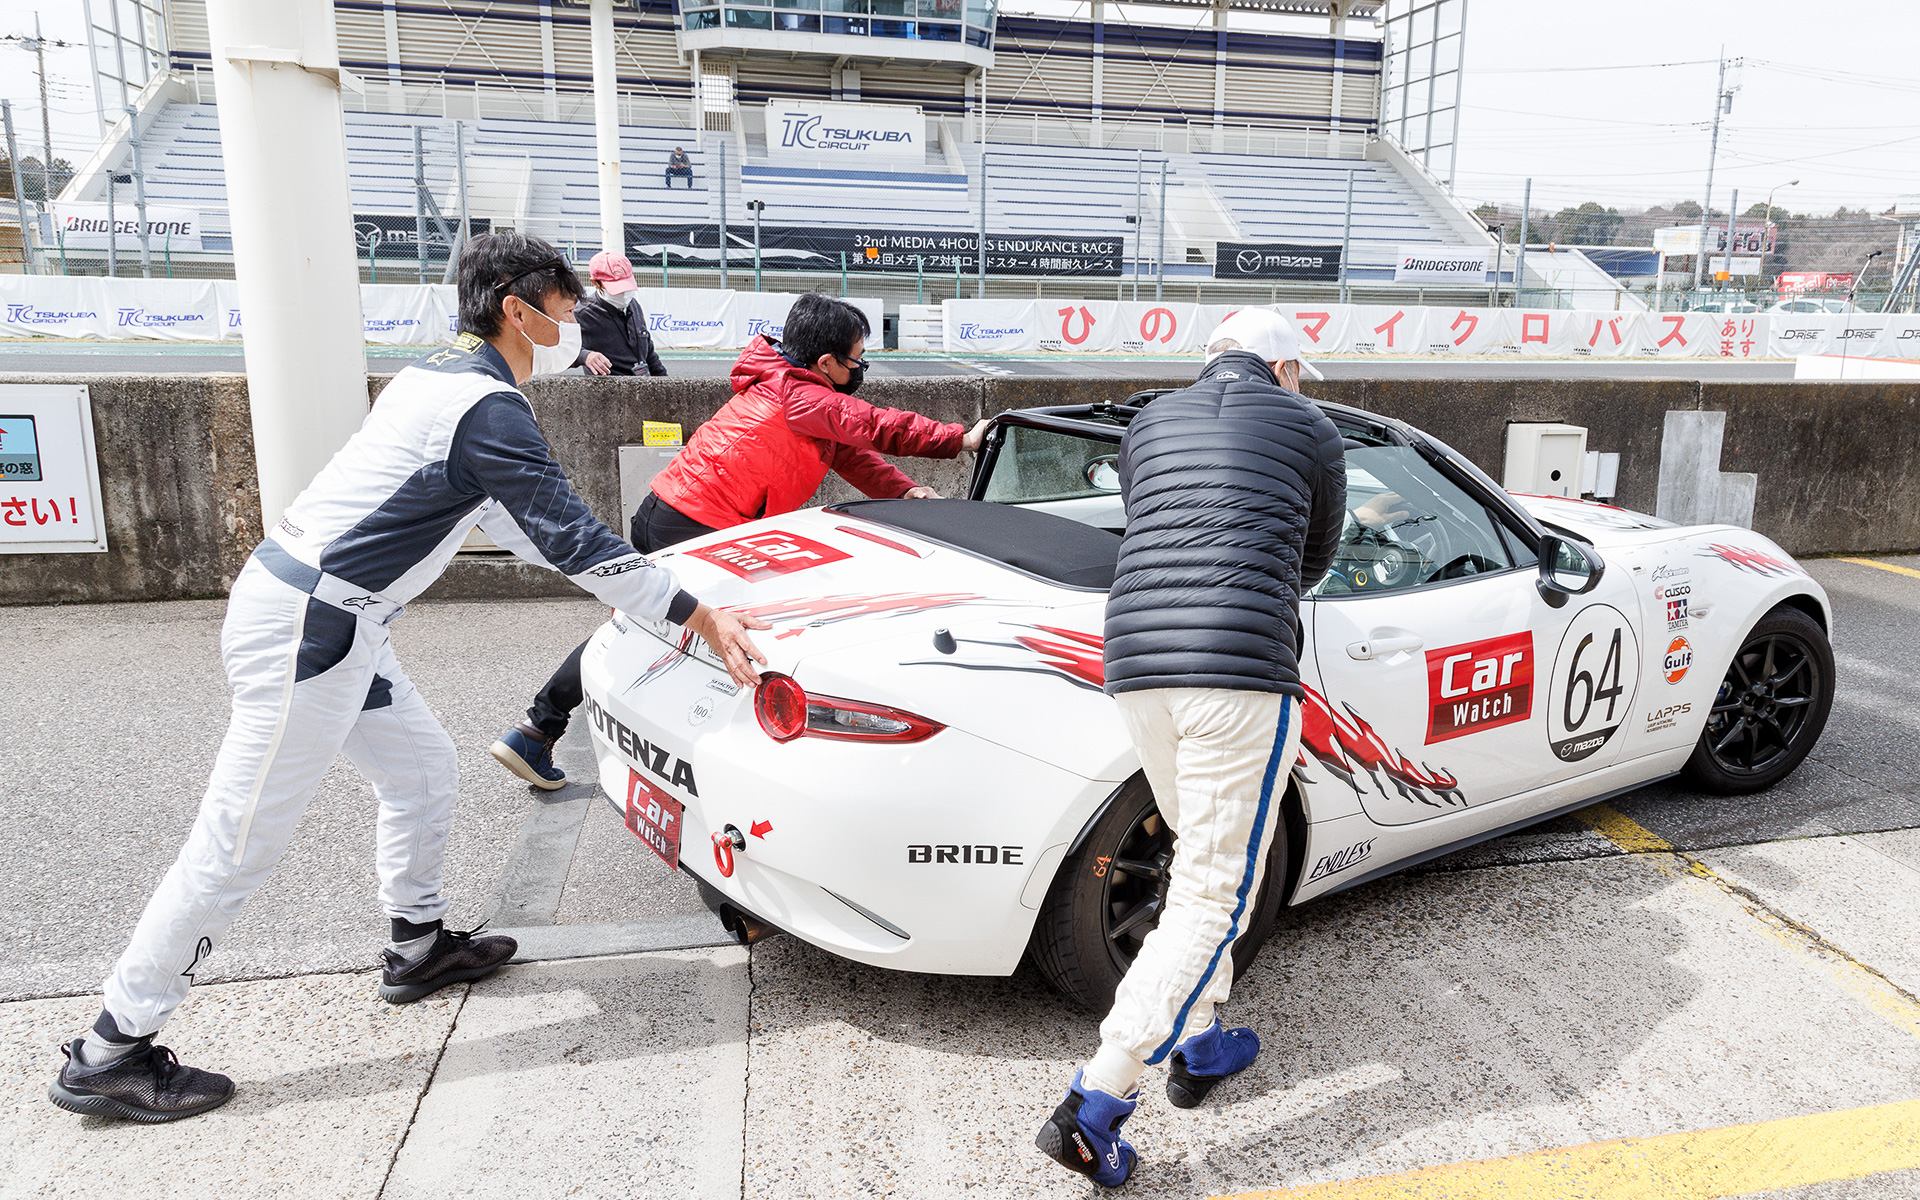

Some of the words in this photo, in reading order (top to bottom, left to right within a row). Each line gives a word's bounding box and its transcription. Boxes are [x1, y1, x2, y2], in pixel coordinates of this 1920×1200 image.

[822, 128, 912, 143] TSUKUBA
[818, 141, 870, 151] CIRCUIT
[854, 235, 887, 247] 32nd
[891, 236, 936, 249] MEDIA
[998, 240, 1078, 253] ENDURANCE
[1081, 242, 1113, 254] RACE
[1265, 256, 1323, 268] mazda
[1403, 258, 1484, 272] BRIDGESTONE
[1721, 319, 1755, 338] あり
[1721, 339, 1755, 357] ます
[735, 534, 823, 561] Car
[1664, 586, 1691, 598] CUSCO
[1664, 652, 1692, 670] Gulf
[1441, 652, 1523, 699] Car
[1563, 627, 1623, 732] 64
[693, 705, 708, 718] 100
[1453, 693, 1512, 727] Watch
[1647, 702, 1692, 722] LAPPS
[585, 688, 699, 798] POTENZA
[1573, 736, 1605, 753] mazda
[632, 780, 674, 833] Car
[636, 814, 666, 854] Watch
[907, 845, 1023, 865] BRIDE
[1308, 836, 1377, 879] ENDLESS
[1093, 854, 1112, 877] 64
